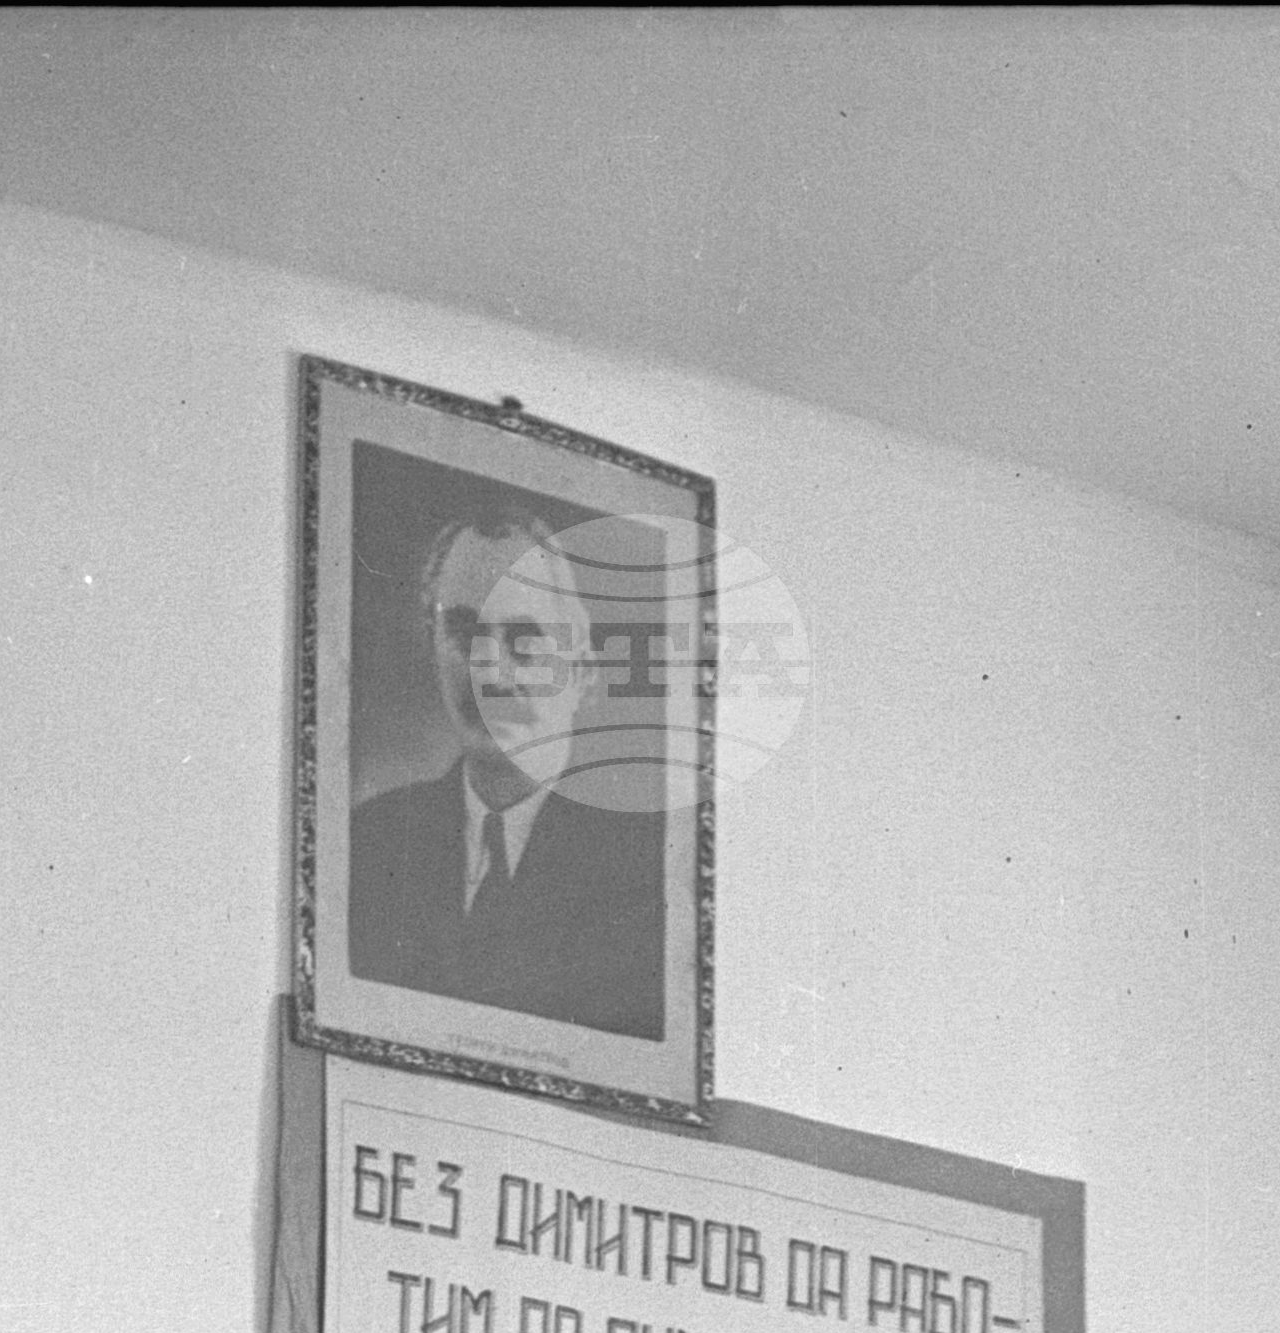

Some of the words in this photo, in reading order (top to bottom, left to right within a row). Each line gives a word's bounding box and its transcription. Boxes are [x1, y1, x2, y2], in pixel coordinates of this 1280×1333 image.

[353, 1145, 464, 1239] БЕЗ
[495, 1173, 766, 1303] ДИМИТРОВ
[786, 1238, 849, 1322] ДА
